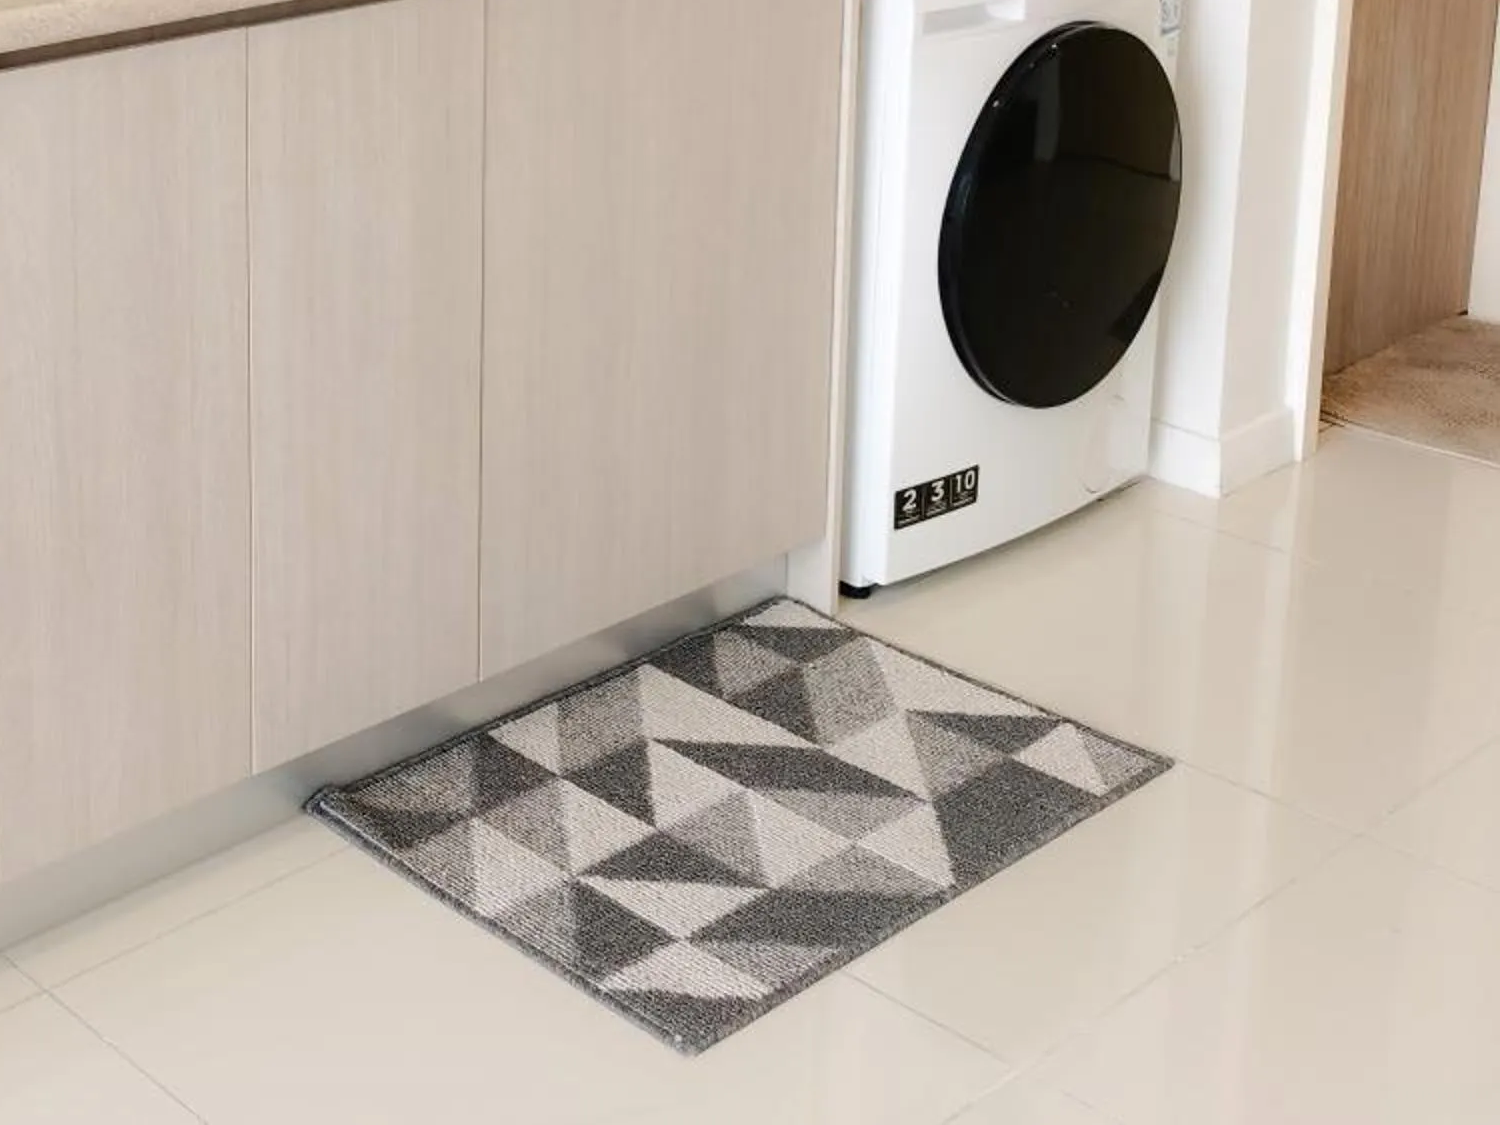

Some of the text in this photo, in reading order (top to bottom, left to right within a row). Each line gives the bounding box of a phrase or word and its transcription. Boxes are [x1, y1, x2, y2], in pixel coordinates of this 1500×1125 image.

[902, 489, 917, 511] 2
[931, 479, 945, 502] 3
[955, 470, 976, 493] 10
